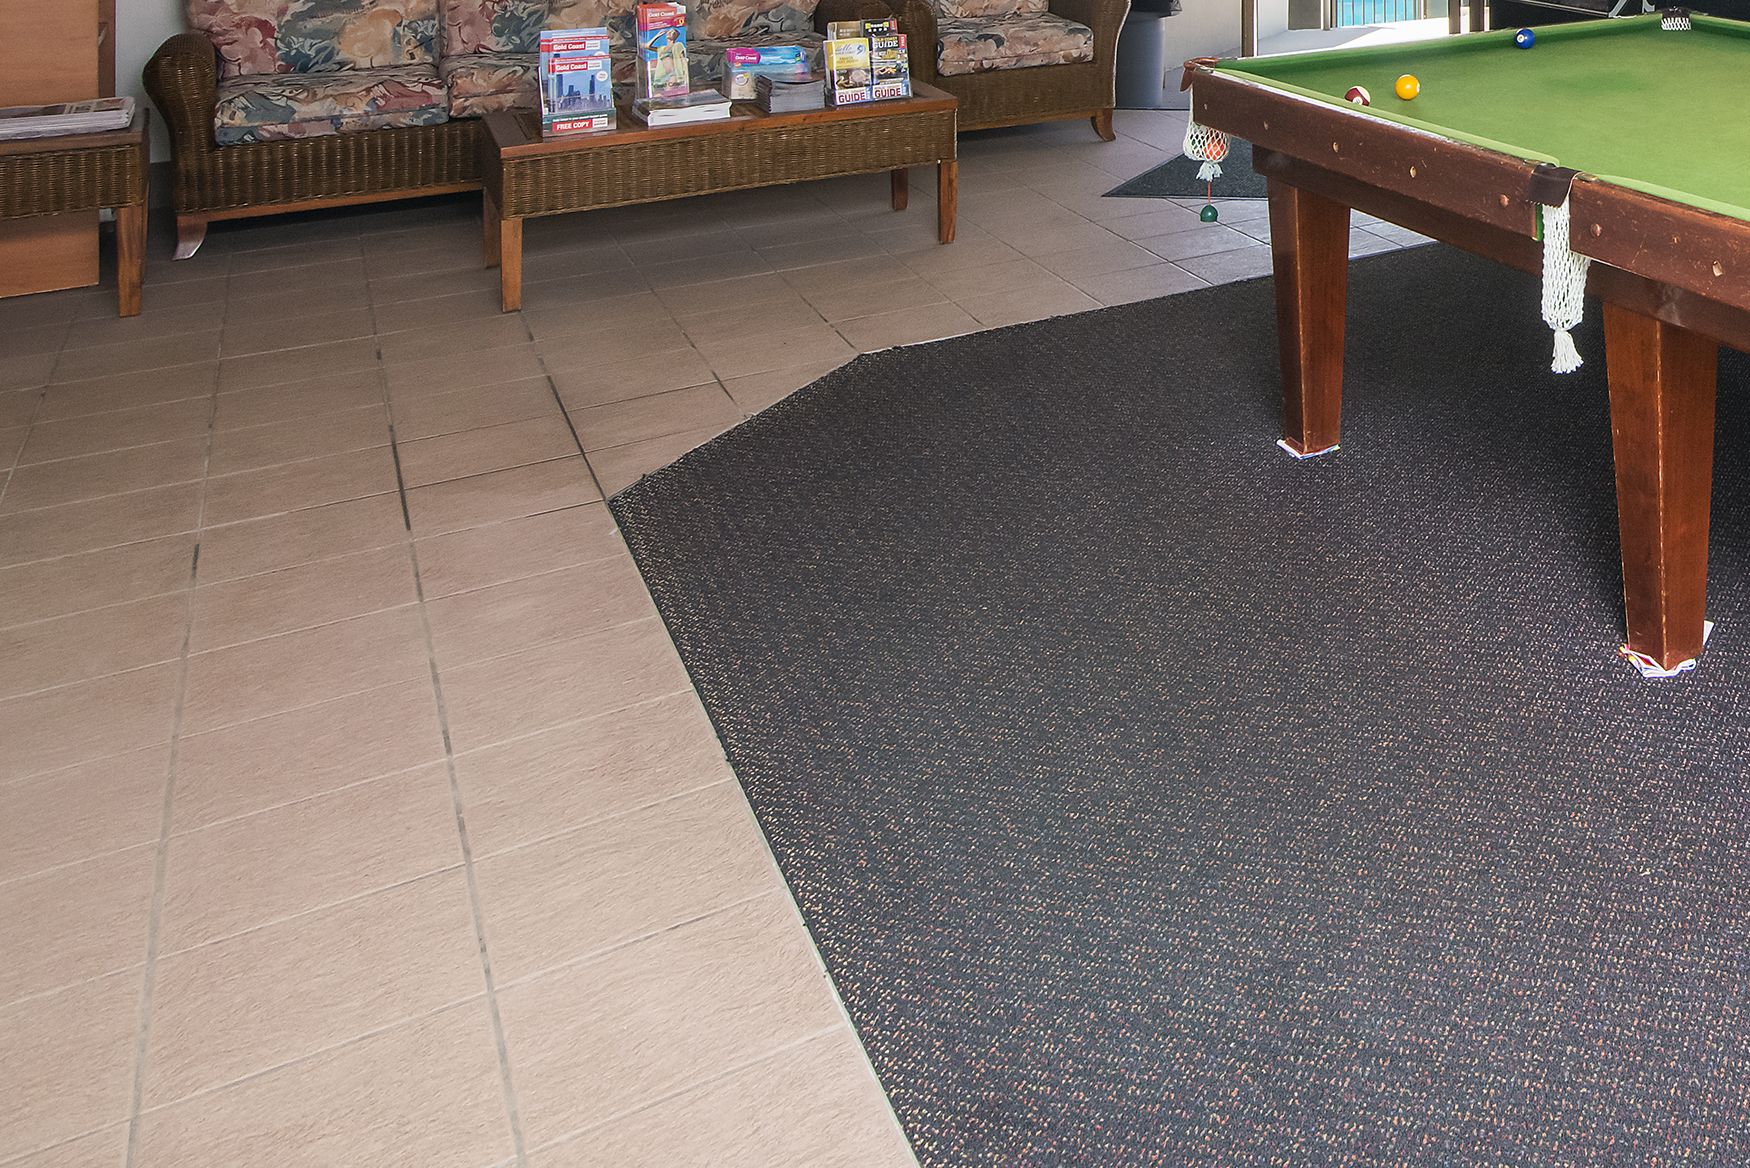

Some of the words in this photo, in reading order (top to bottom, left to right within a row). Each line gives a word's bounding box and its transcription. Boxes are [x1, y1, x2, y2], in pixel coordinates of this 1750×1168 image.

[873, 40, 898, 49] GUIDE
[838, 92, 866, 103] GUIDE
[874, 88, 901, 98] GUIDE
[556, 122, 572, 130] FREE
[573, 121, 589, 129] COPY
